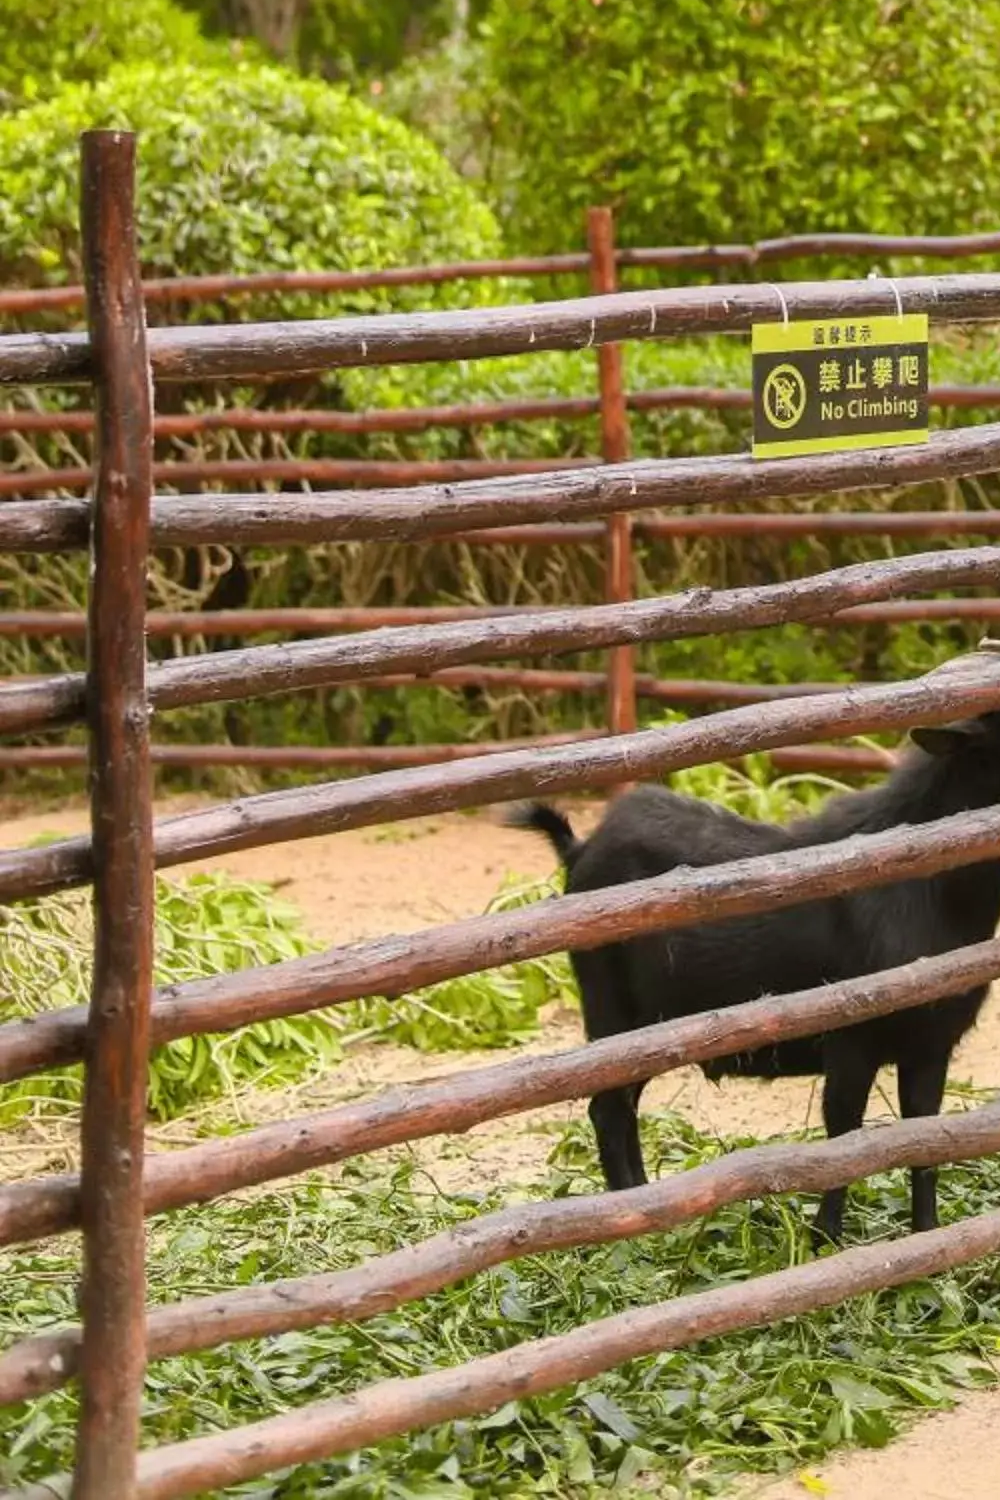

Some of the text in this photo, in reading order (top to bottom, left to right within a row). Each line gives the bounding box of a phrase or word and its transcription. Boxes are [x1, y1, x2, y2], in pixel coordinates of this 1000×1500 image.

[818, 355, 920, 393] 禁止攀爬
[820, 395, 919, 421] No Climbing
